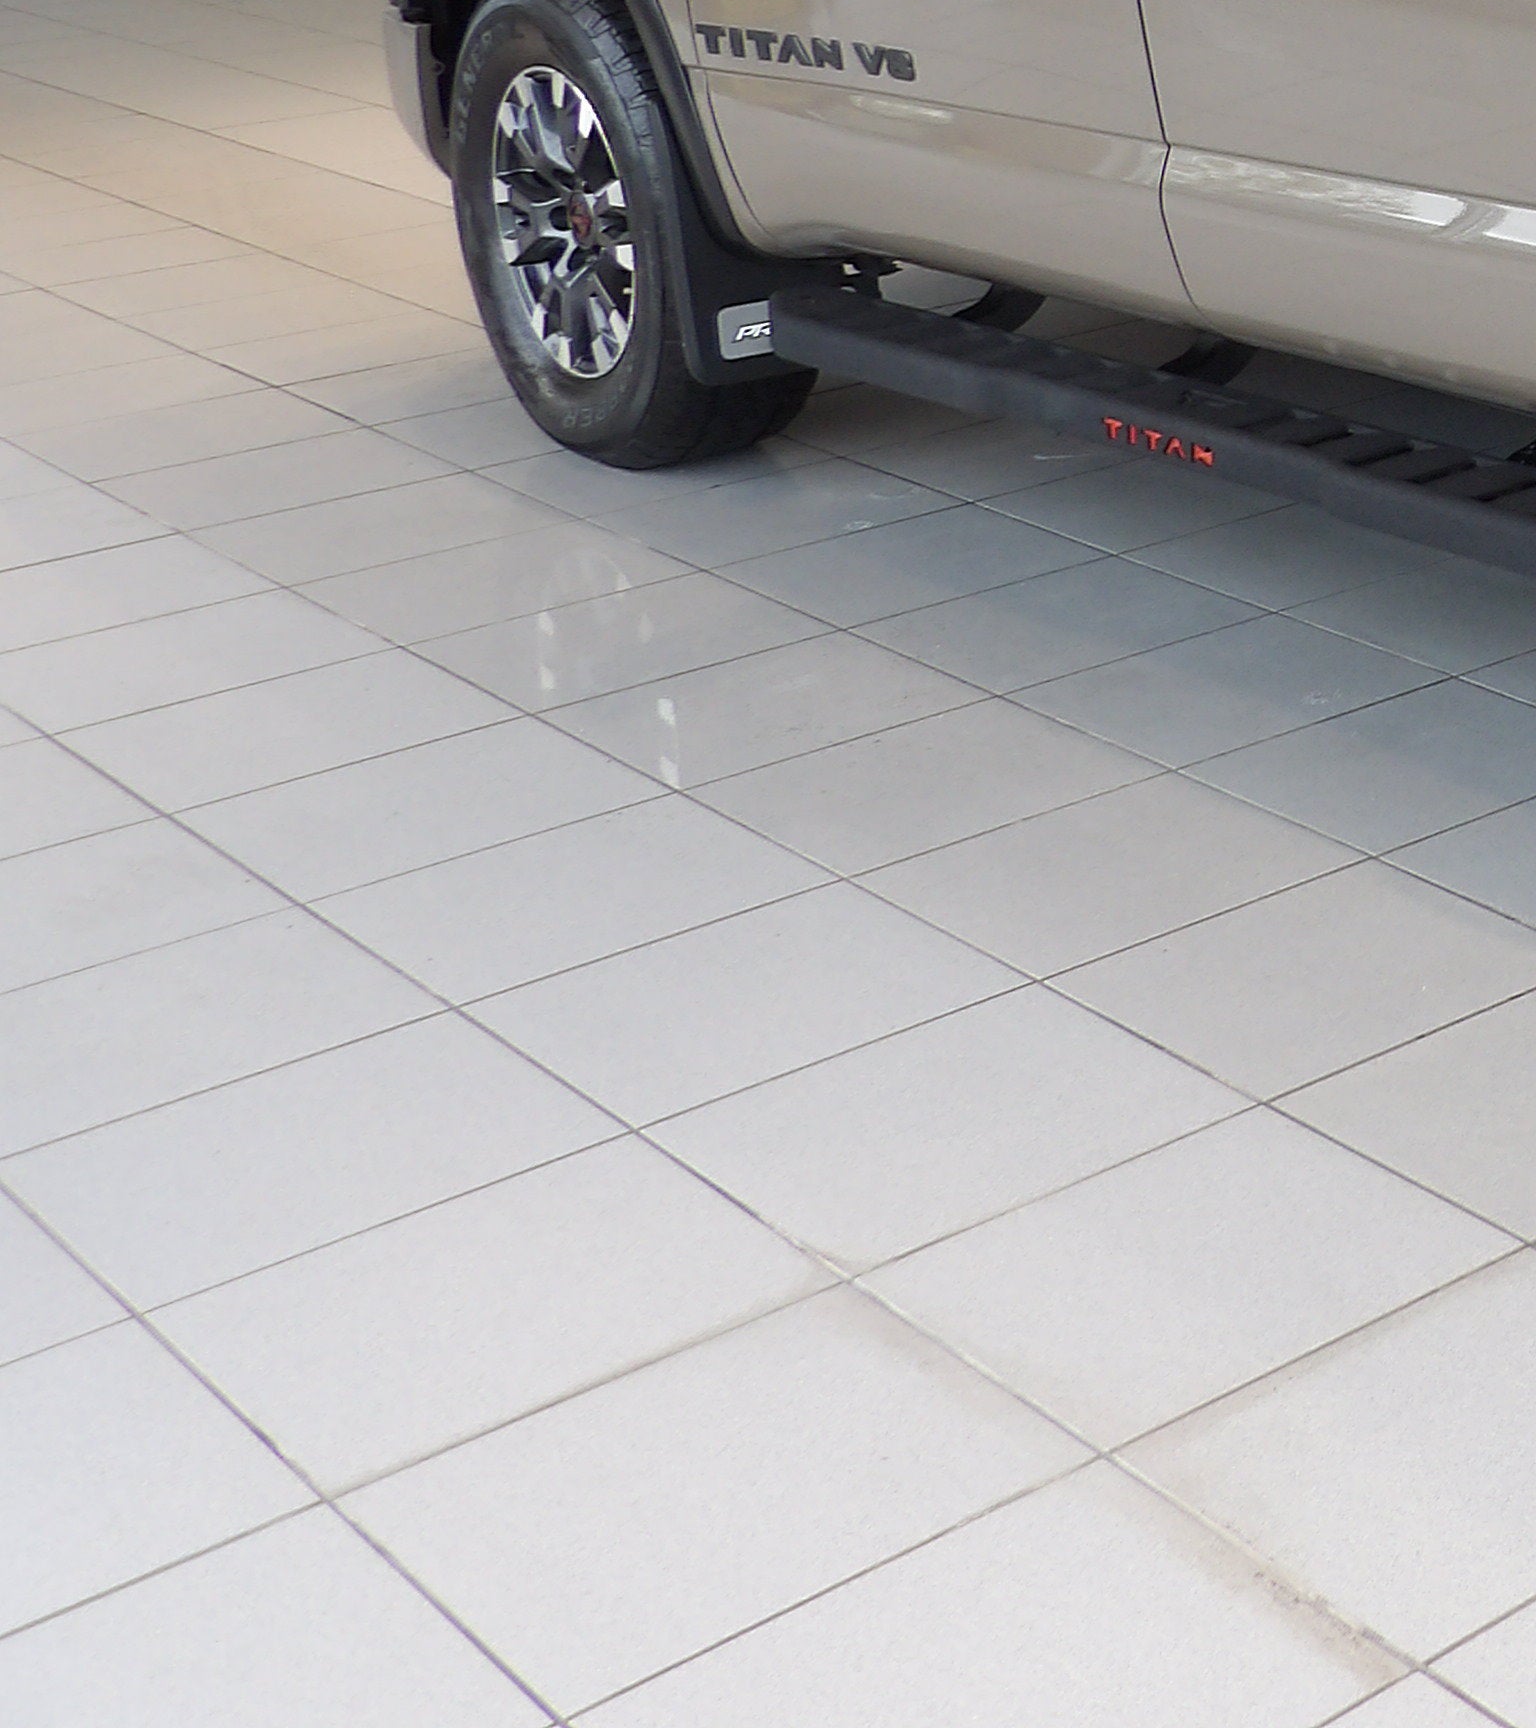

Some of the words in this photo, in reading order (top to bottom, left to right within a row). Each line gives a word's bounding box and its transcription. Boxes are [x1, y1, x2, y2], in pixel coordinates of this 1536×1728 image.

[696, 24, 844, 71] TITAN
[853, 41, 916, 82] V8
[1103, 416, 1215, 468] TITAN
